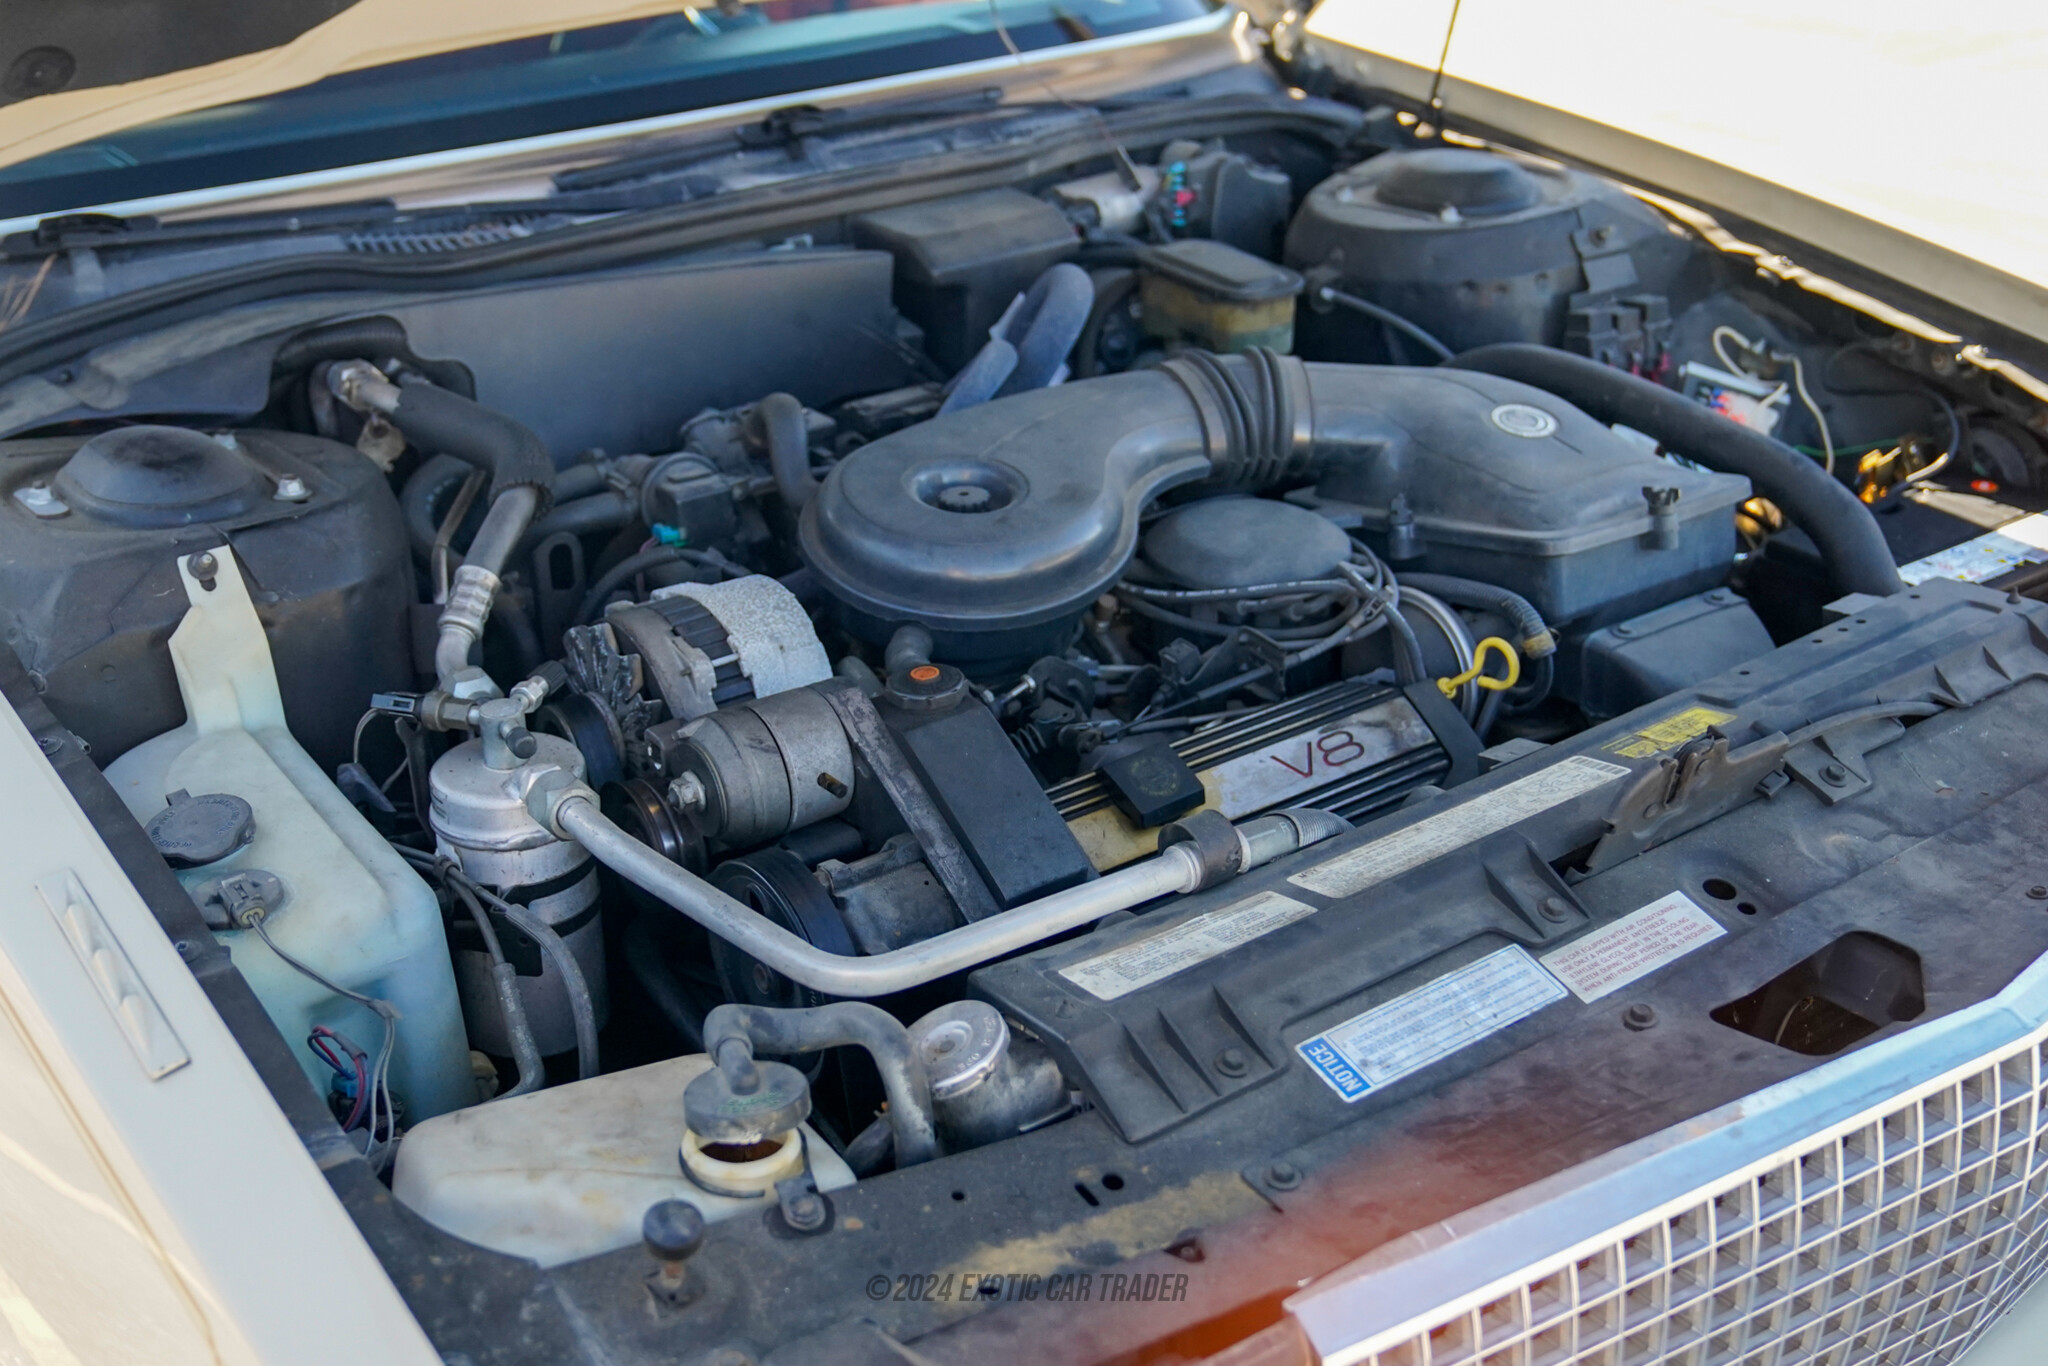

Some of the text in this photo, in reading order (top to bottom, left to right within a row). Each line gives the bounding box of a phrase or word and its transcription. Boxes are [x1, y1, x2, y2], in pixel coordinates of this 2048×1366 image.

[1270, 730, 1365, 779] V8
[1560, 965, 1574, 973] USE
[1573, 956, 1590, 967] ONLY
[1595, 936, 1631, 956] PERMANENT
[1567, 951, 1583, 960] CAR
[1580, 937, 1611, 954] EQUIPPED
[1609, 929, 1626, 939] WITH
[1624, 924, 1637, 932] AIR
[1599, 960, 1624, 974] DURING
[1622, 952, 1639, 962] THAT
[1638, 941, 1662, 954] PERIOD
[1669, 930, 1683, 938] THE
[1600, 949, 1625, 963] GLYCOL
[1661, 916, 1690, 932] COOLING
[1308, 1043, 1363, 1092] NOTICE
